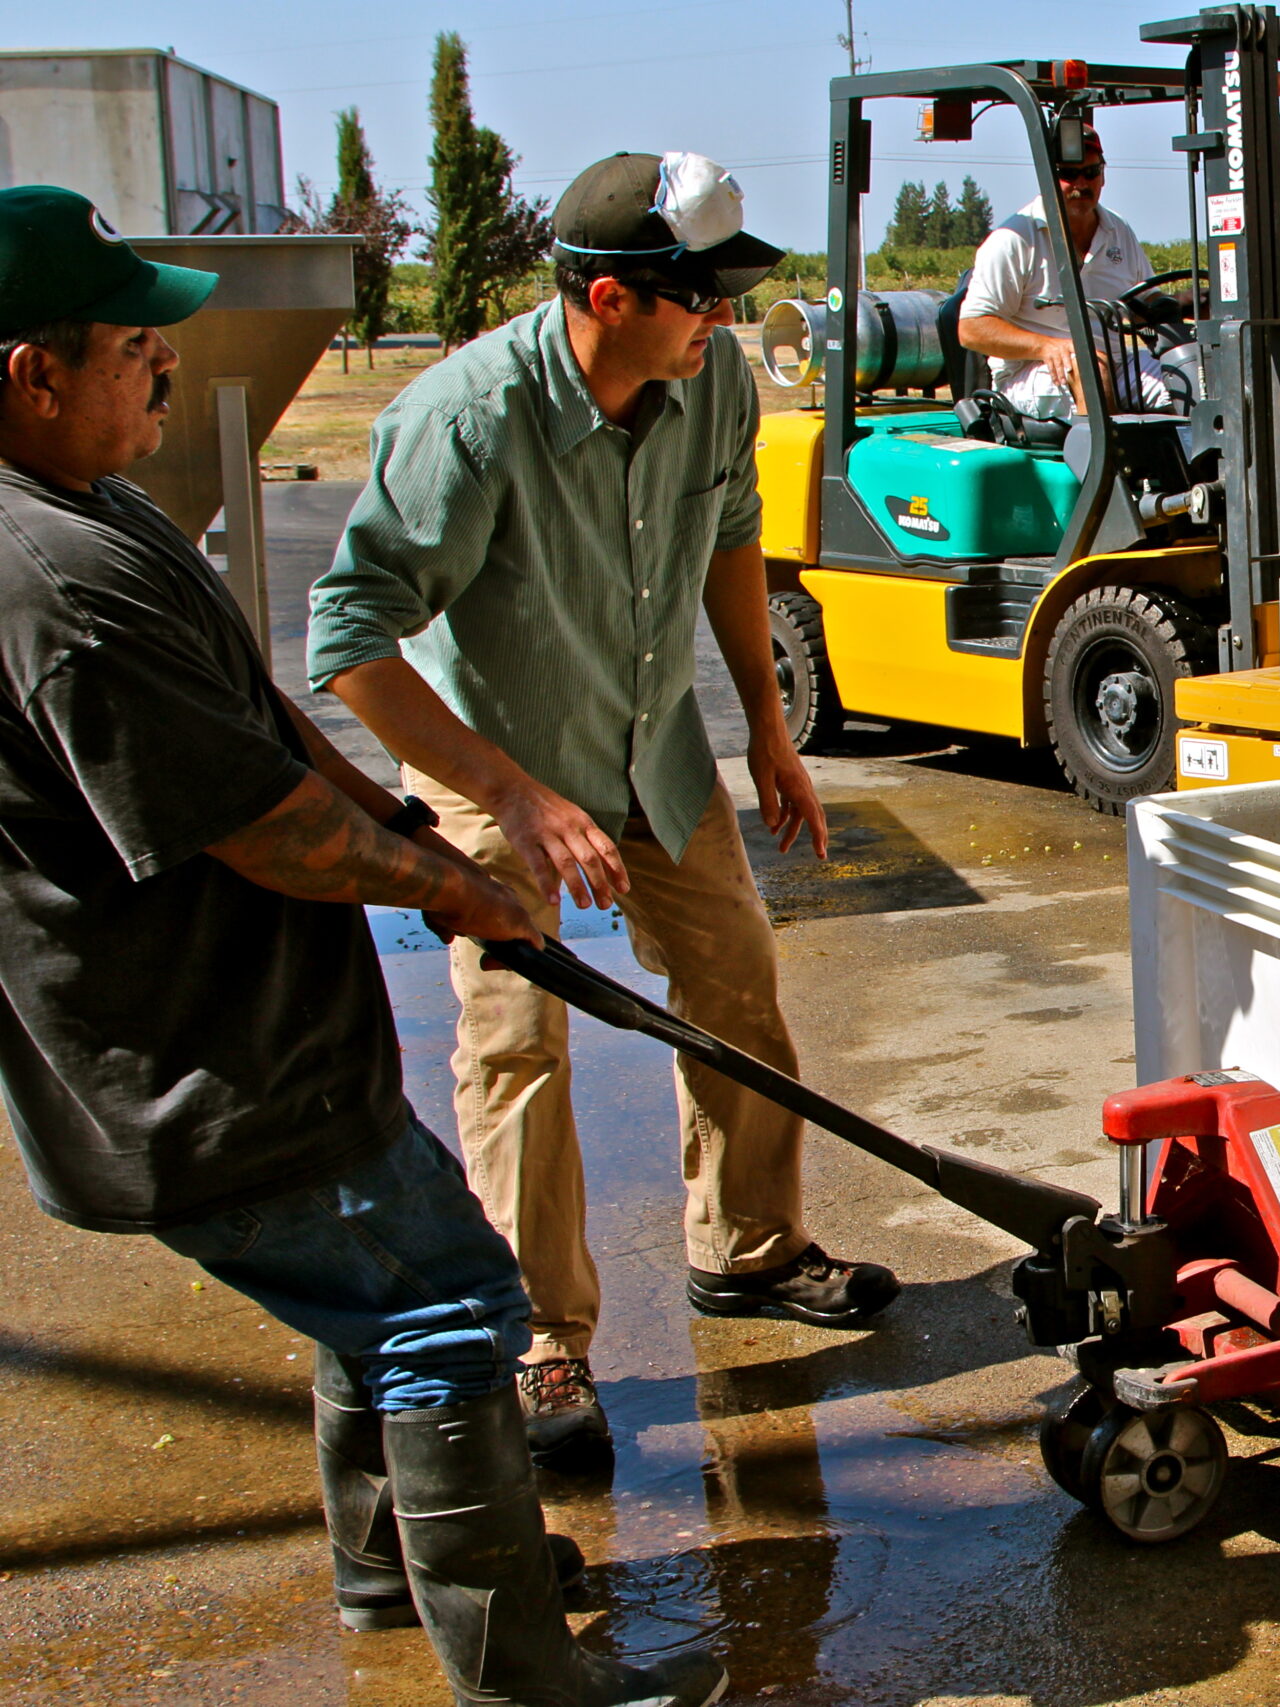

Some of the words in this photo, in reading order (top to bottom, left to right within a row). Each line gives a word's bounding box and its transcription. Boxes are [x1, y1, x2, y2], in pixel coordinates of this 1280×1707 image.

[1222, 50, 1244, 190] KOMATSU
[898, 514, 940, 533] KOMATSU
[910, 496, 929, 516] 25
[1060, 609, 1150, 665] CONTINENTAL
